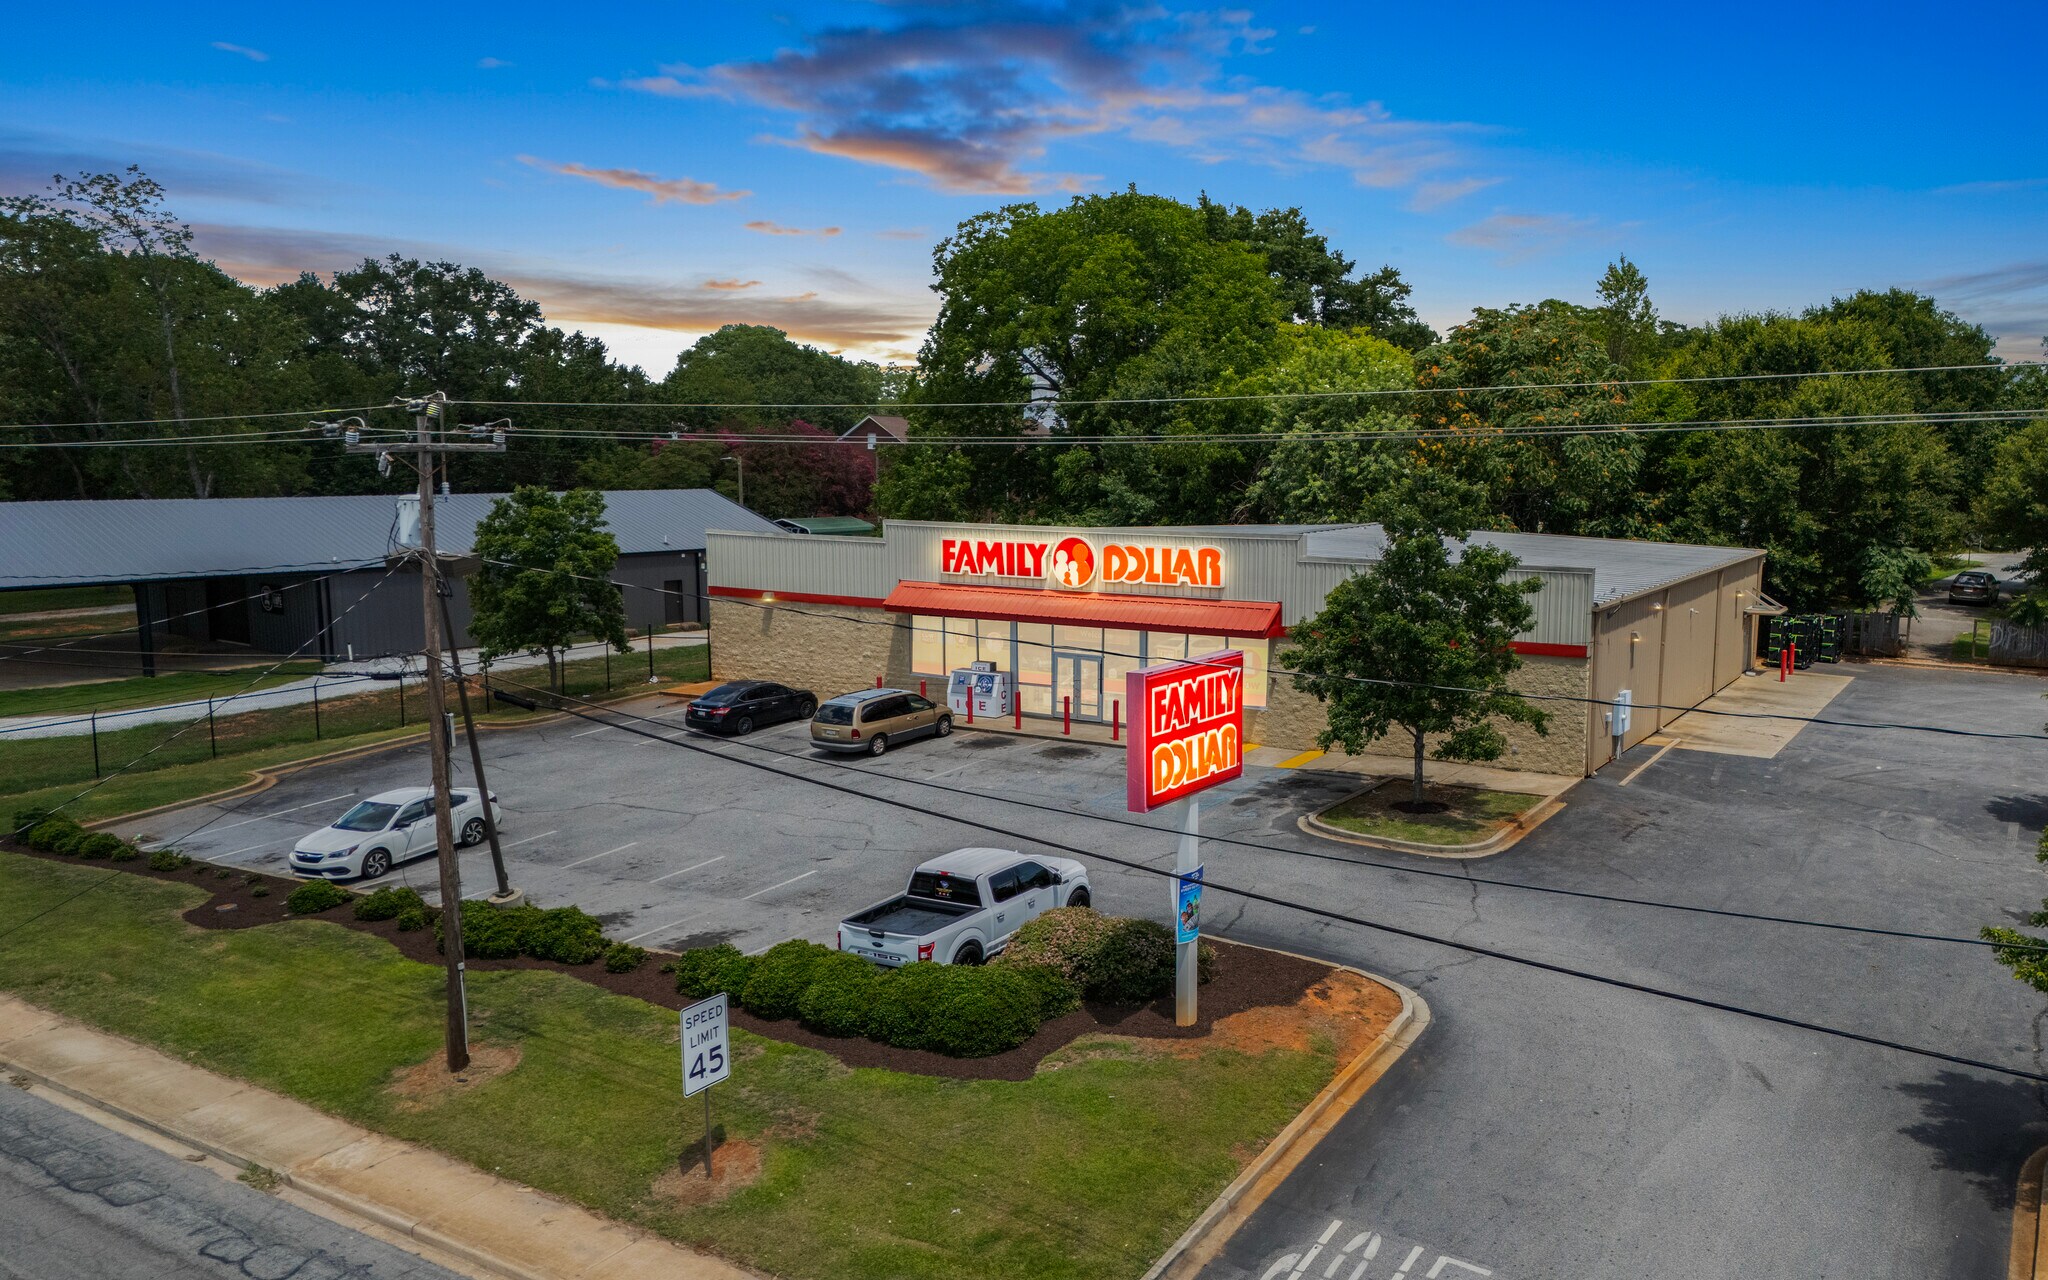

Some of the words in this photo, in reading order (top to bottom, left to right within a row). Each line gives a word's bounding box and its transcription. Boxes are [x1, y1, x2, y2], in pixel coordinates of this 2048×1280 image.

[942, 538, 1049, 578] FAMILY
[1102, 544, 1221, 586] DOLLAR
[956, 699, 987, 711] IE
[1152, 667, 1241, 737] FAMILY
[1152, 723, 1237, 796] DOLLAR
[685, 1004, 723, 1030] SPEED
[690, 1026, 719, 1049] LIMIT
[689, 1044, 724, 1079] 45
